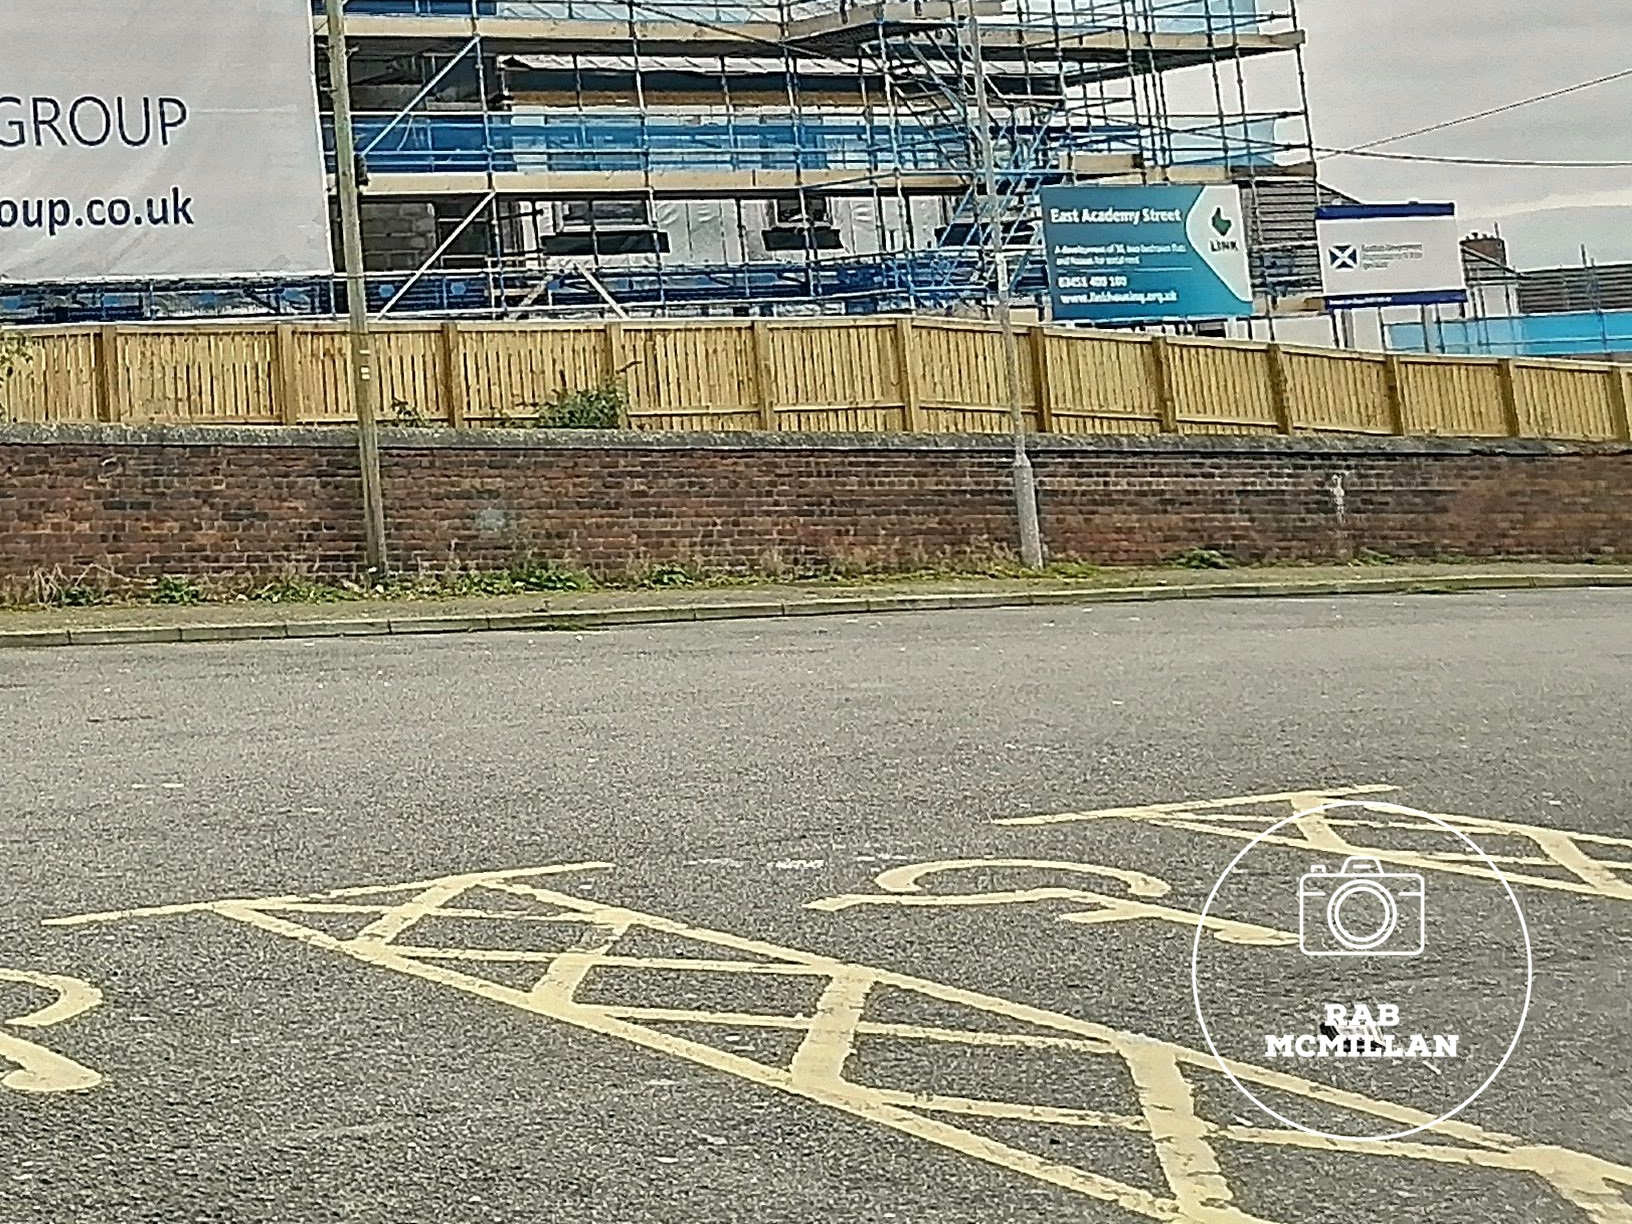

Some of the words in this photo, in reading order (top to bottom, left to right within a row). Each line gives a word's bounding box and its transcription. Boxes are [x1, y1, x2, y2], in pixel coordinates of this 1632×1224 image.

[1051, 208, 1079, 223] East
[1081, 207, 1139, 225] Academy
[1142, 207, 1182, 222] Street
[1210, 240, 1239, 253] LINK
